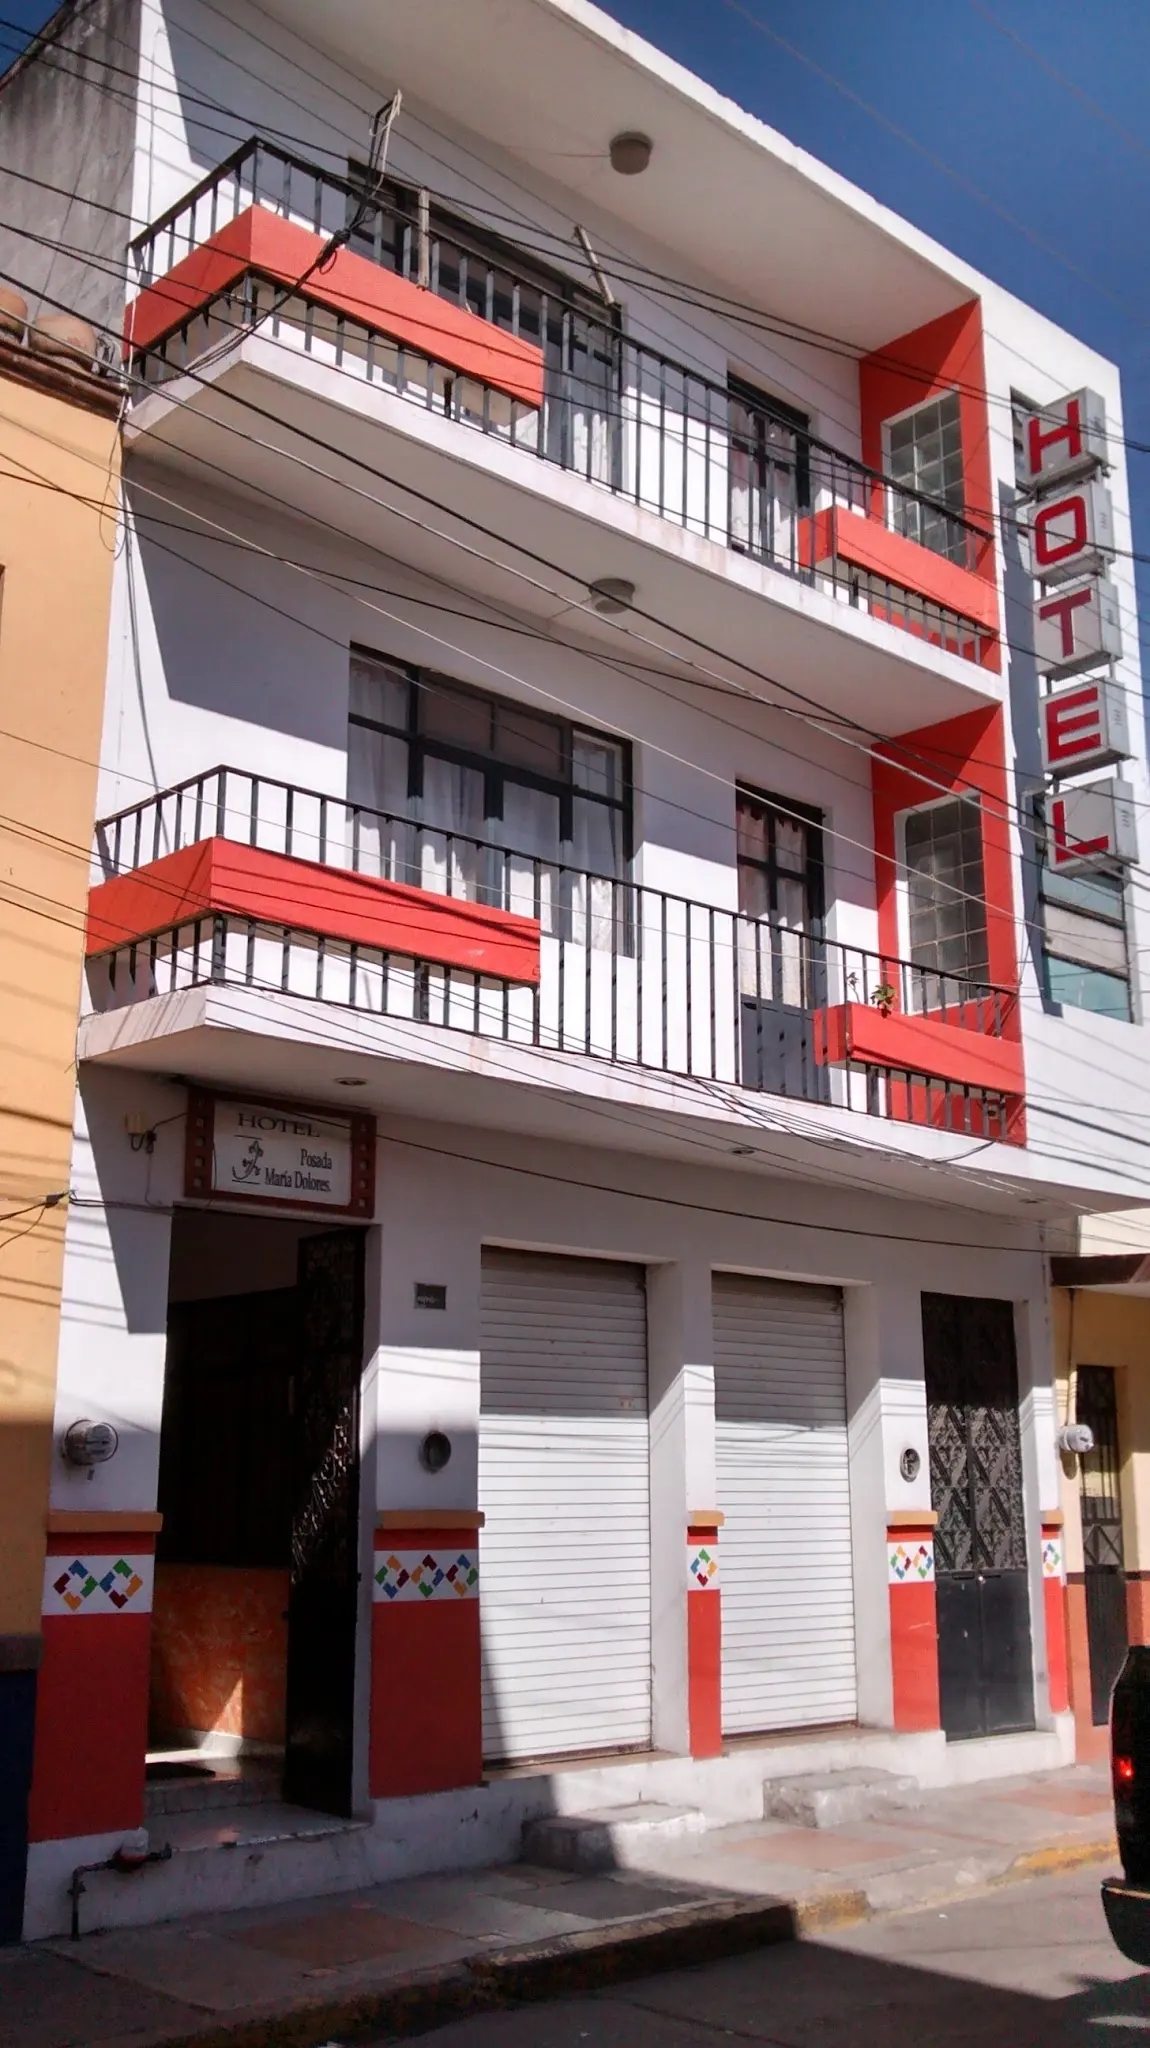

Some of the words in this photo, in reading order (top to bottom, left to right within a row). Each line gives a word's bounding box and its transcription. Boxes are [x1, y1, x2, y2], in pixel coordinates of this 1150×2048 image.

[1028, 398, 1109, 864] HOTEL
[238, 1112, 320, 1138] HOTEL
[300, 1148, 332, 1169] Posada
[264, 1167, 292, 1187] María
